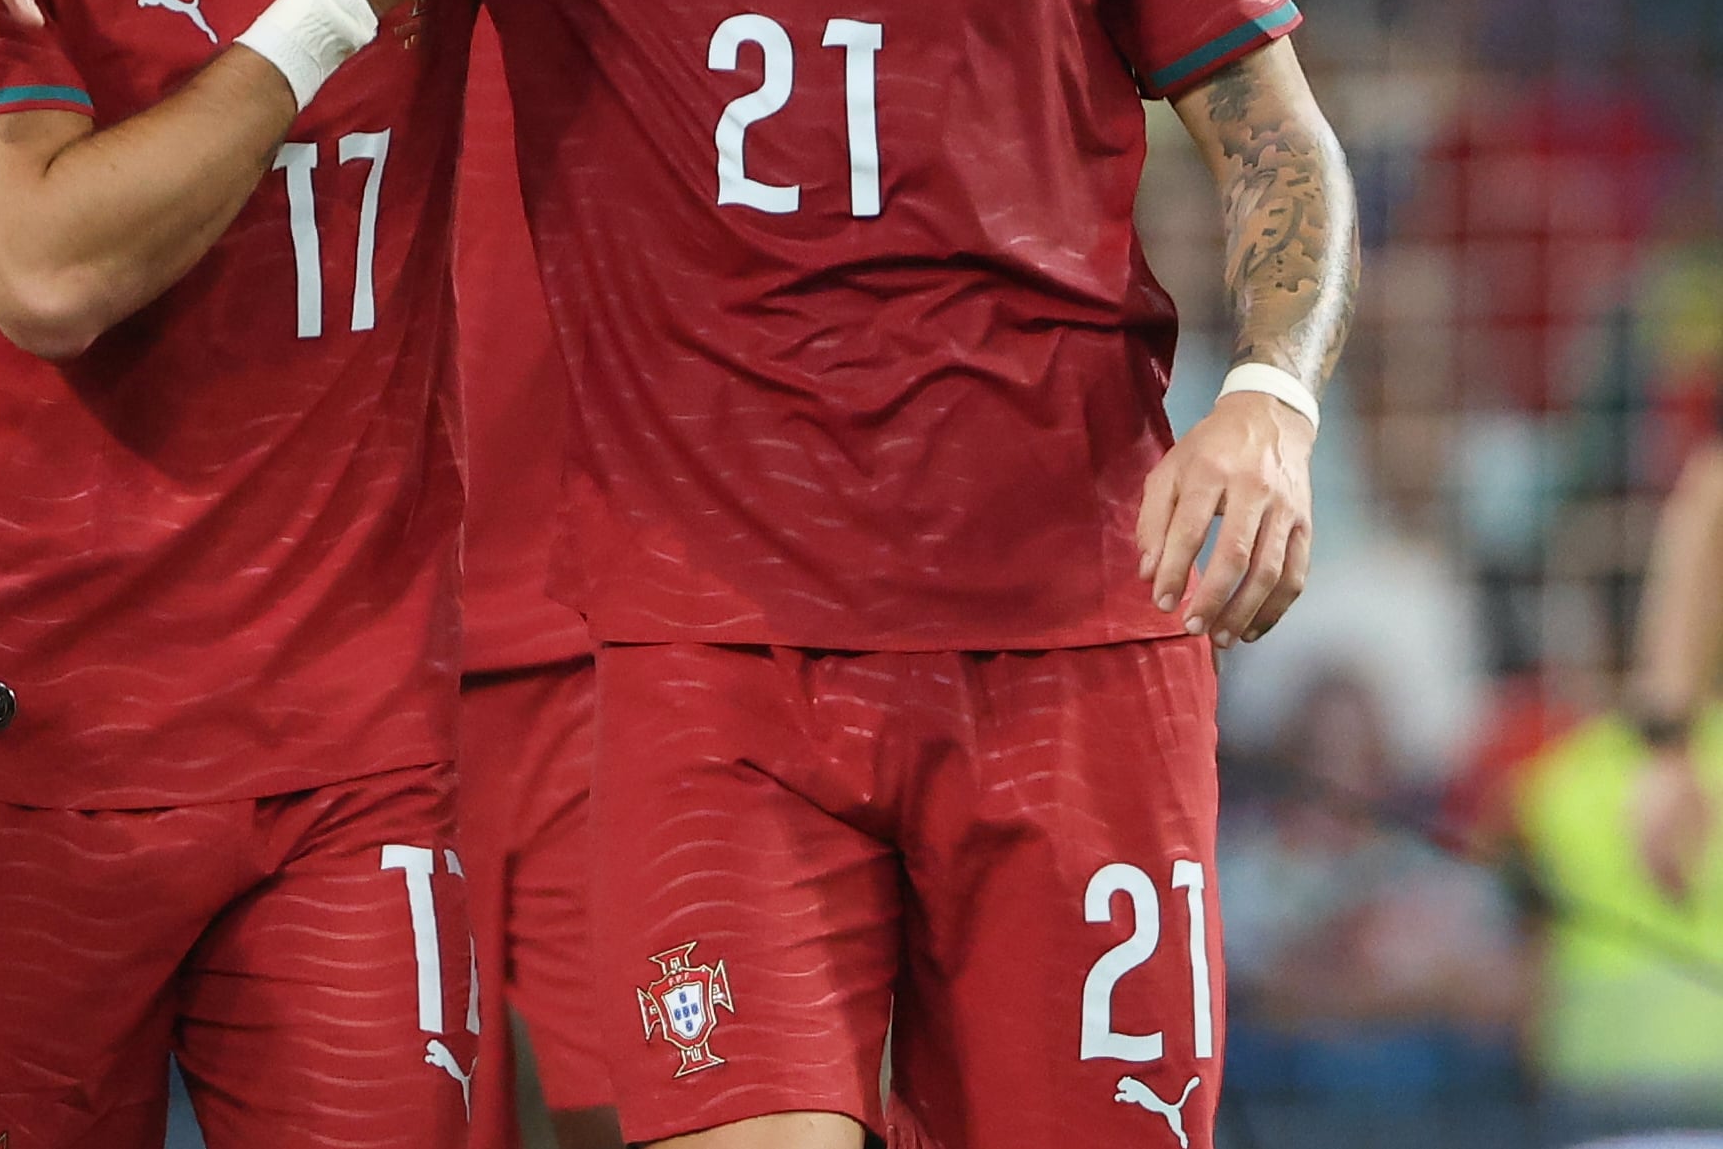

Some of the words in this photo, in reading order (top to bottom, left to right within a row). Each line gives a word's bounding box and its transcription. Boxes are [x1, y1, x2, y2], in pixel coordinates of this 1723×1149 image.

[707, 13, 883, 217] 21
[272, 127, 391, 338] 17
[1080, 859, 1214, 1061] 21
